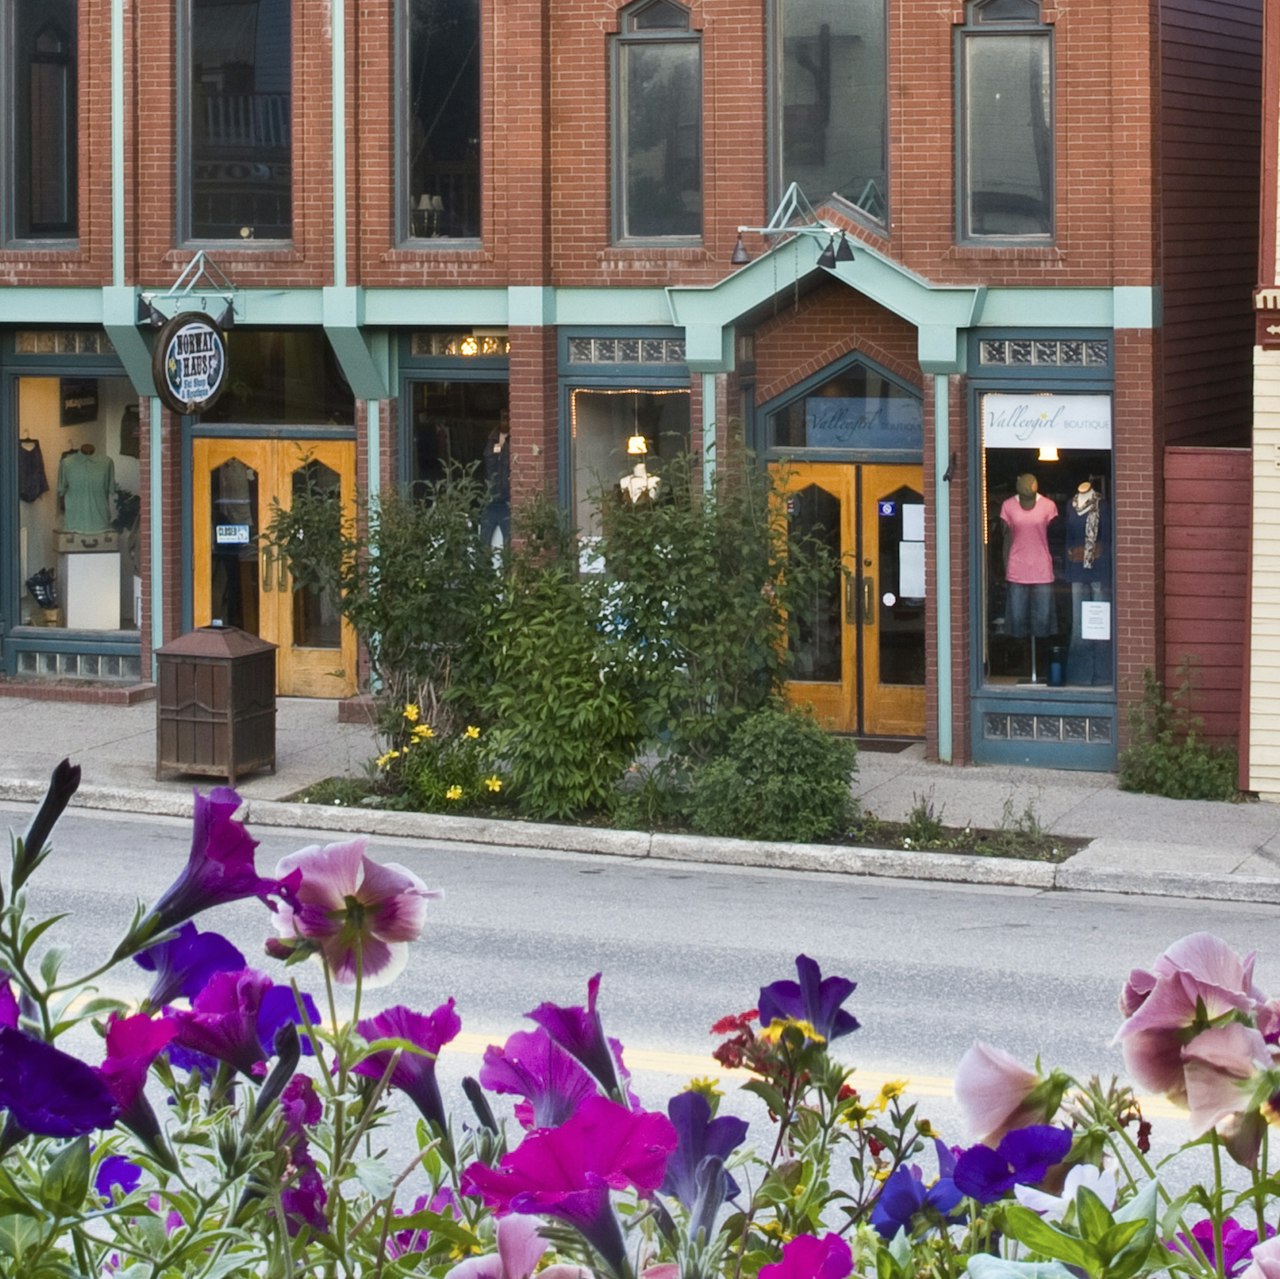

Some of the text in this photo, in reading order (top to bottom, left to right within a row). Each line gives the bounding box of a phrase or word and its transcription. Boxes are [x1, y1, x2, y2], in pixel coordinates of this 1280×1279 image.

[176, 331, 214, 356] NORWAY
[183, 354, 208, 378] HAUS
[989, 404, 1110, 441] Valleygirl BOUTIQUE
